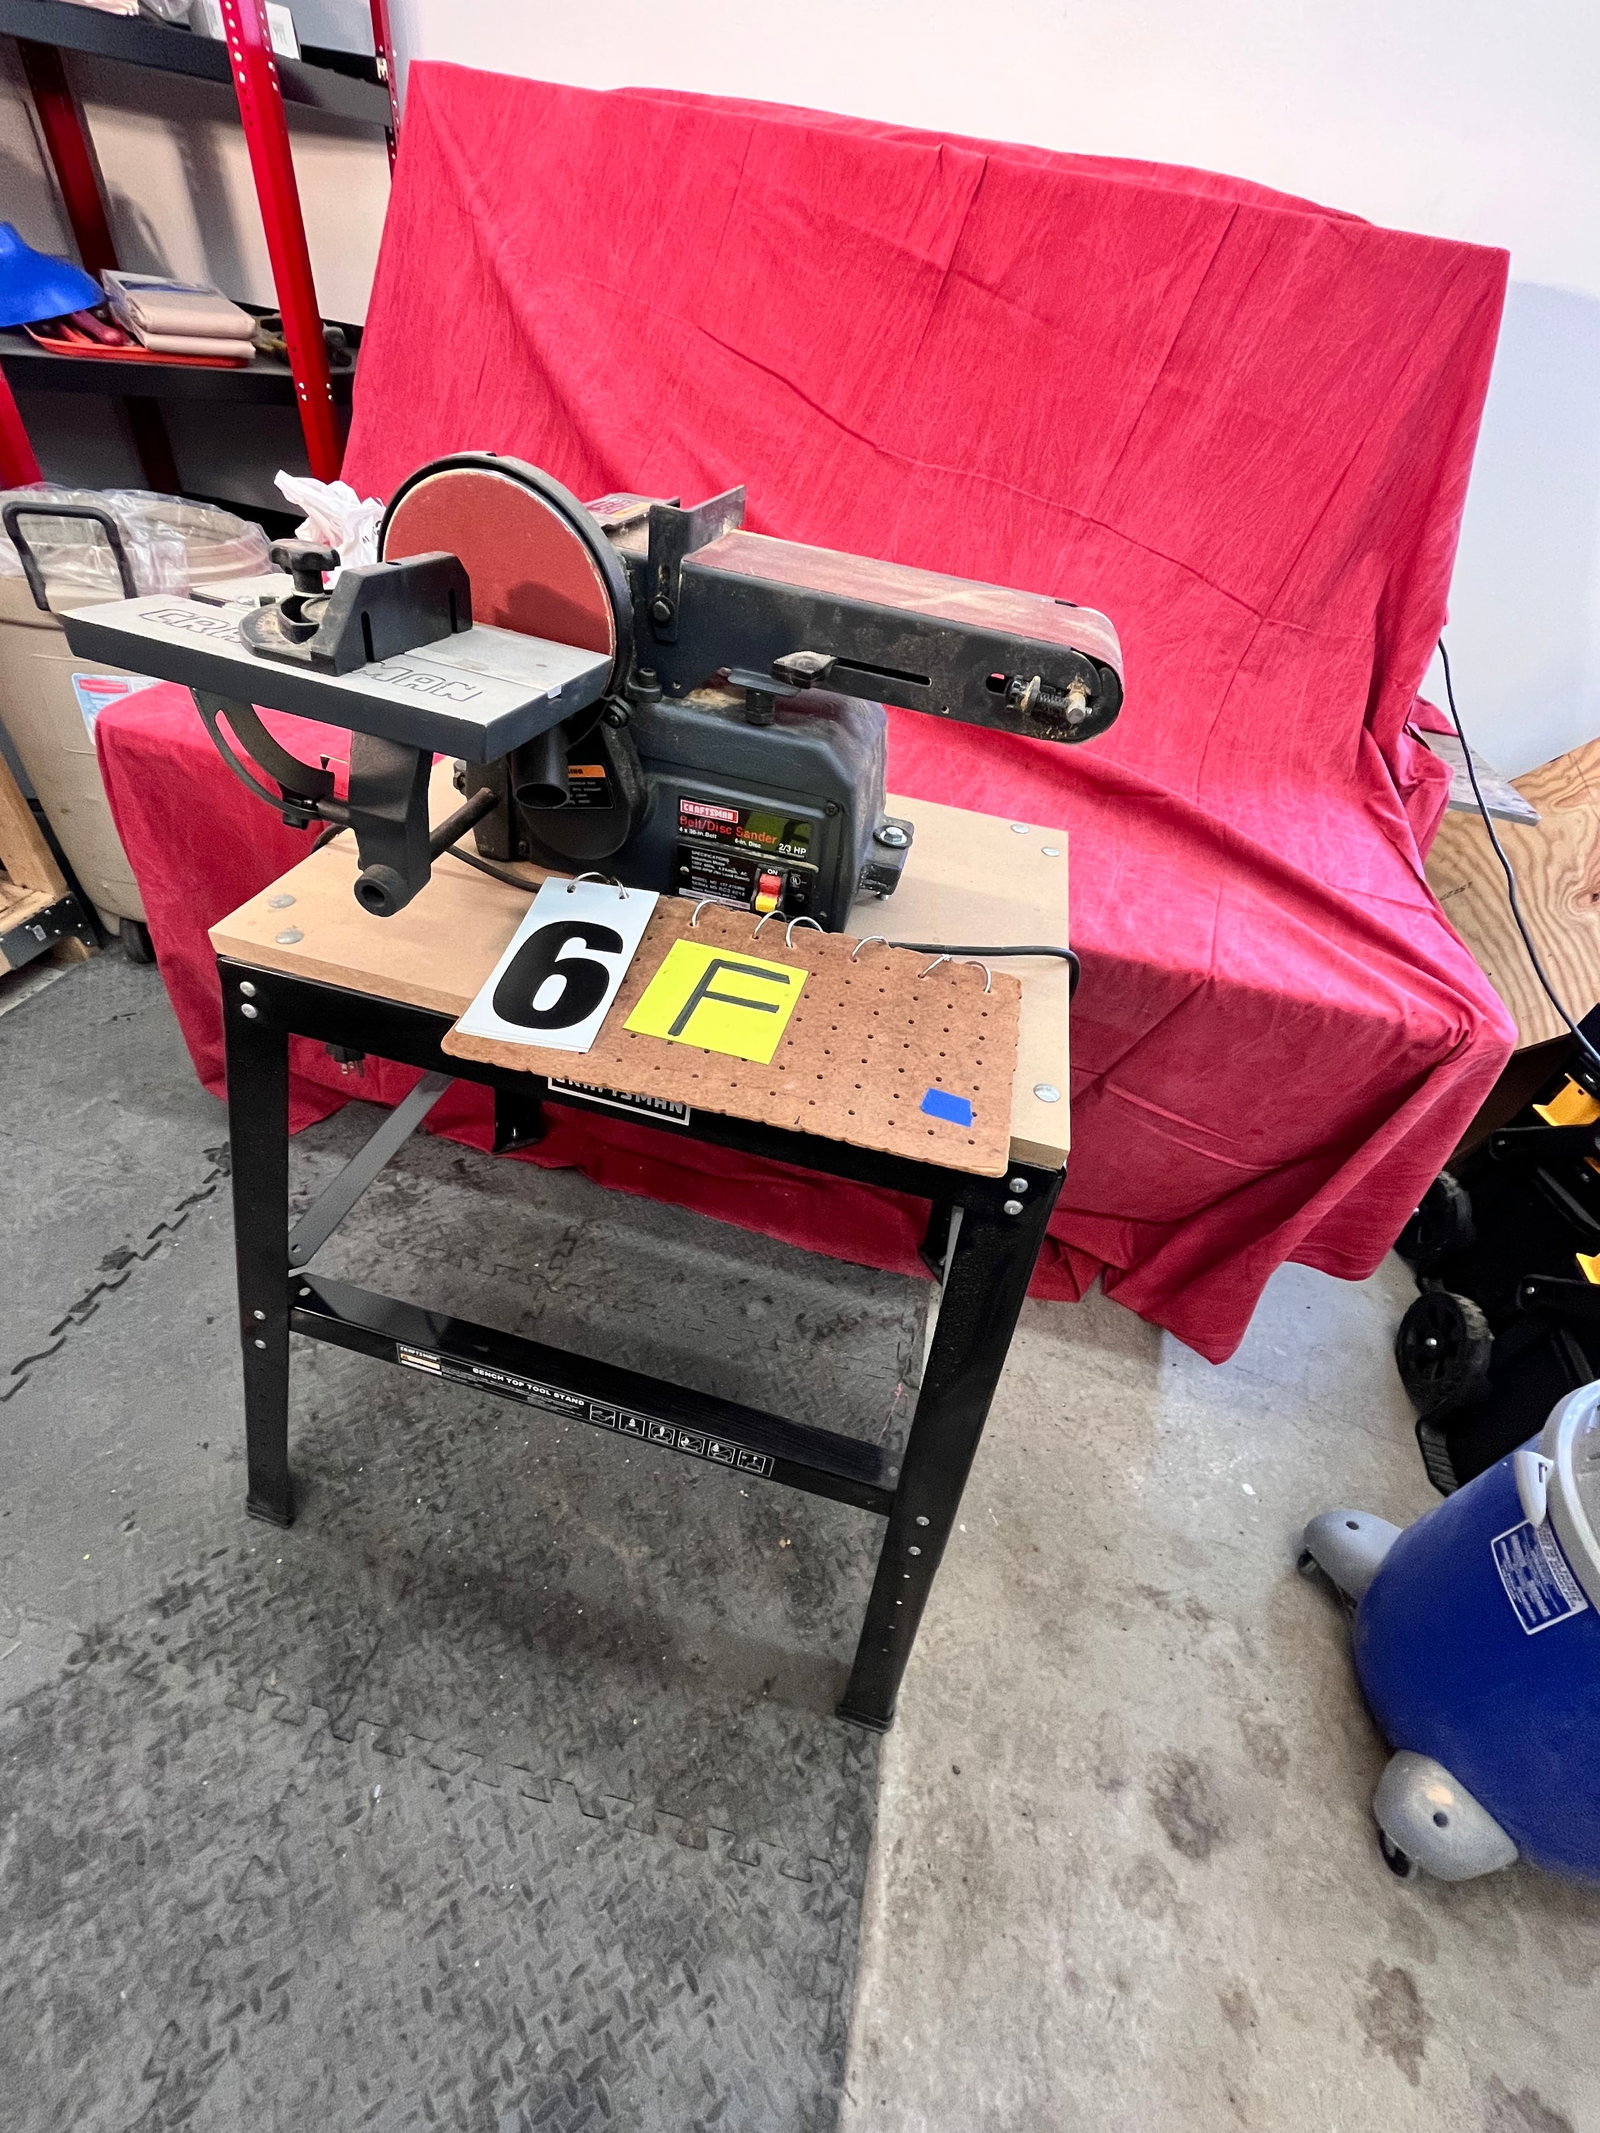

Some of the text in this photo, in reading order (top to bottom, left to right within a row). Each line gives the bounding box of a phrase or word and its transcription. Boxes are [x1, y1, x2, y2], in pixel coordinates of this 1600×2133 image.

[683, 802, 735, 820] CRAFTSMAN
[679, 815, 777, 845] Belt/Disc Sander
[779, 843, 791, 853] 2/3
[793, 846, 807, 855] HP
[492, 920, 624, 1030] 6
[667, 958, 790, 1036] F
[472, 1367, 504, 1381] BENCH
[506, 1377, 524, 1387] TOP
[527, 1384, 551, 1396] TOOL
[553, 1392, 585, 1406] STAND
